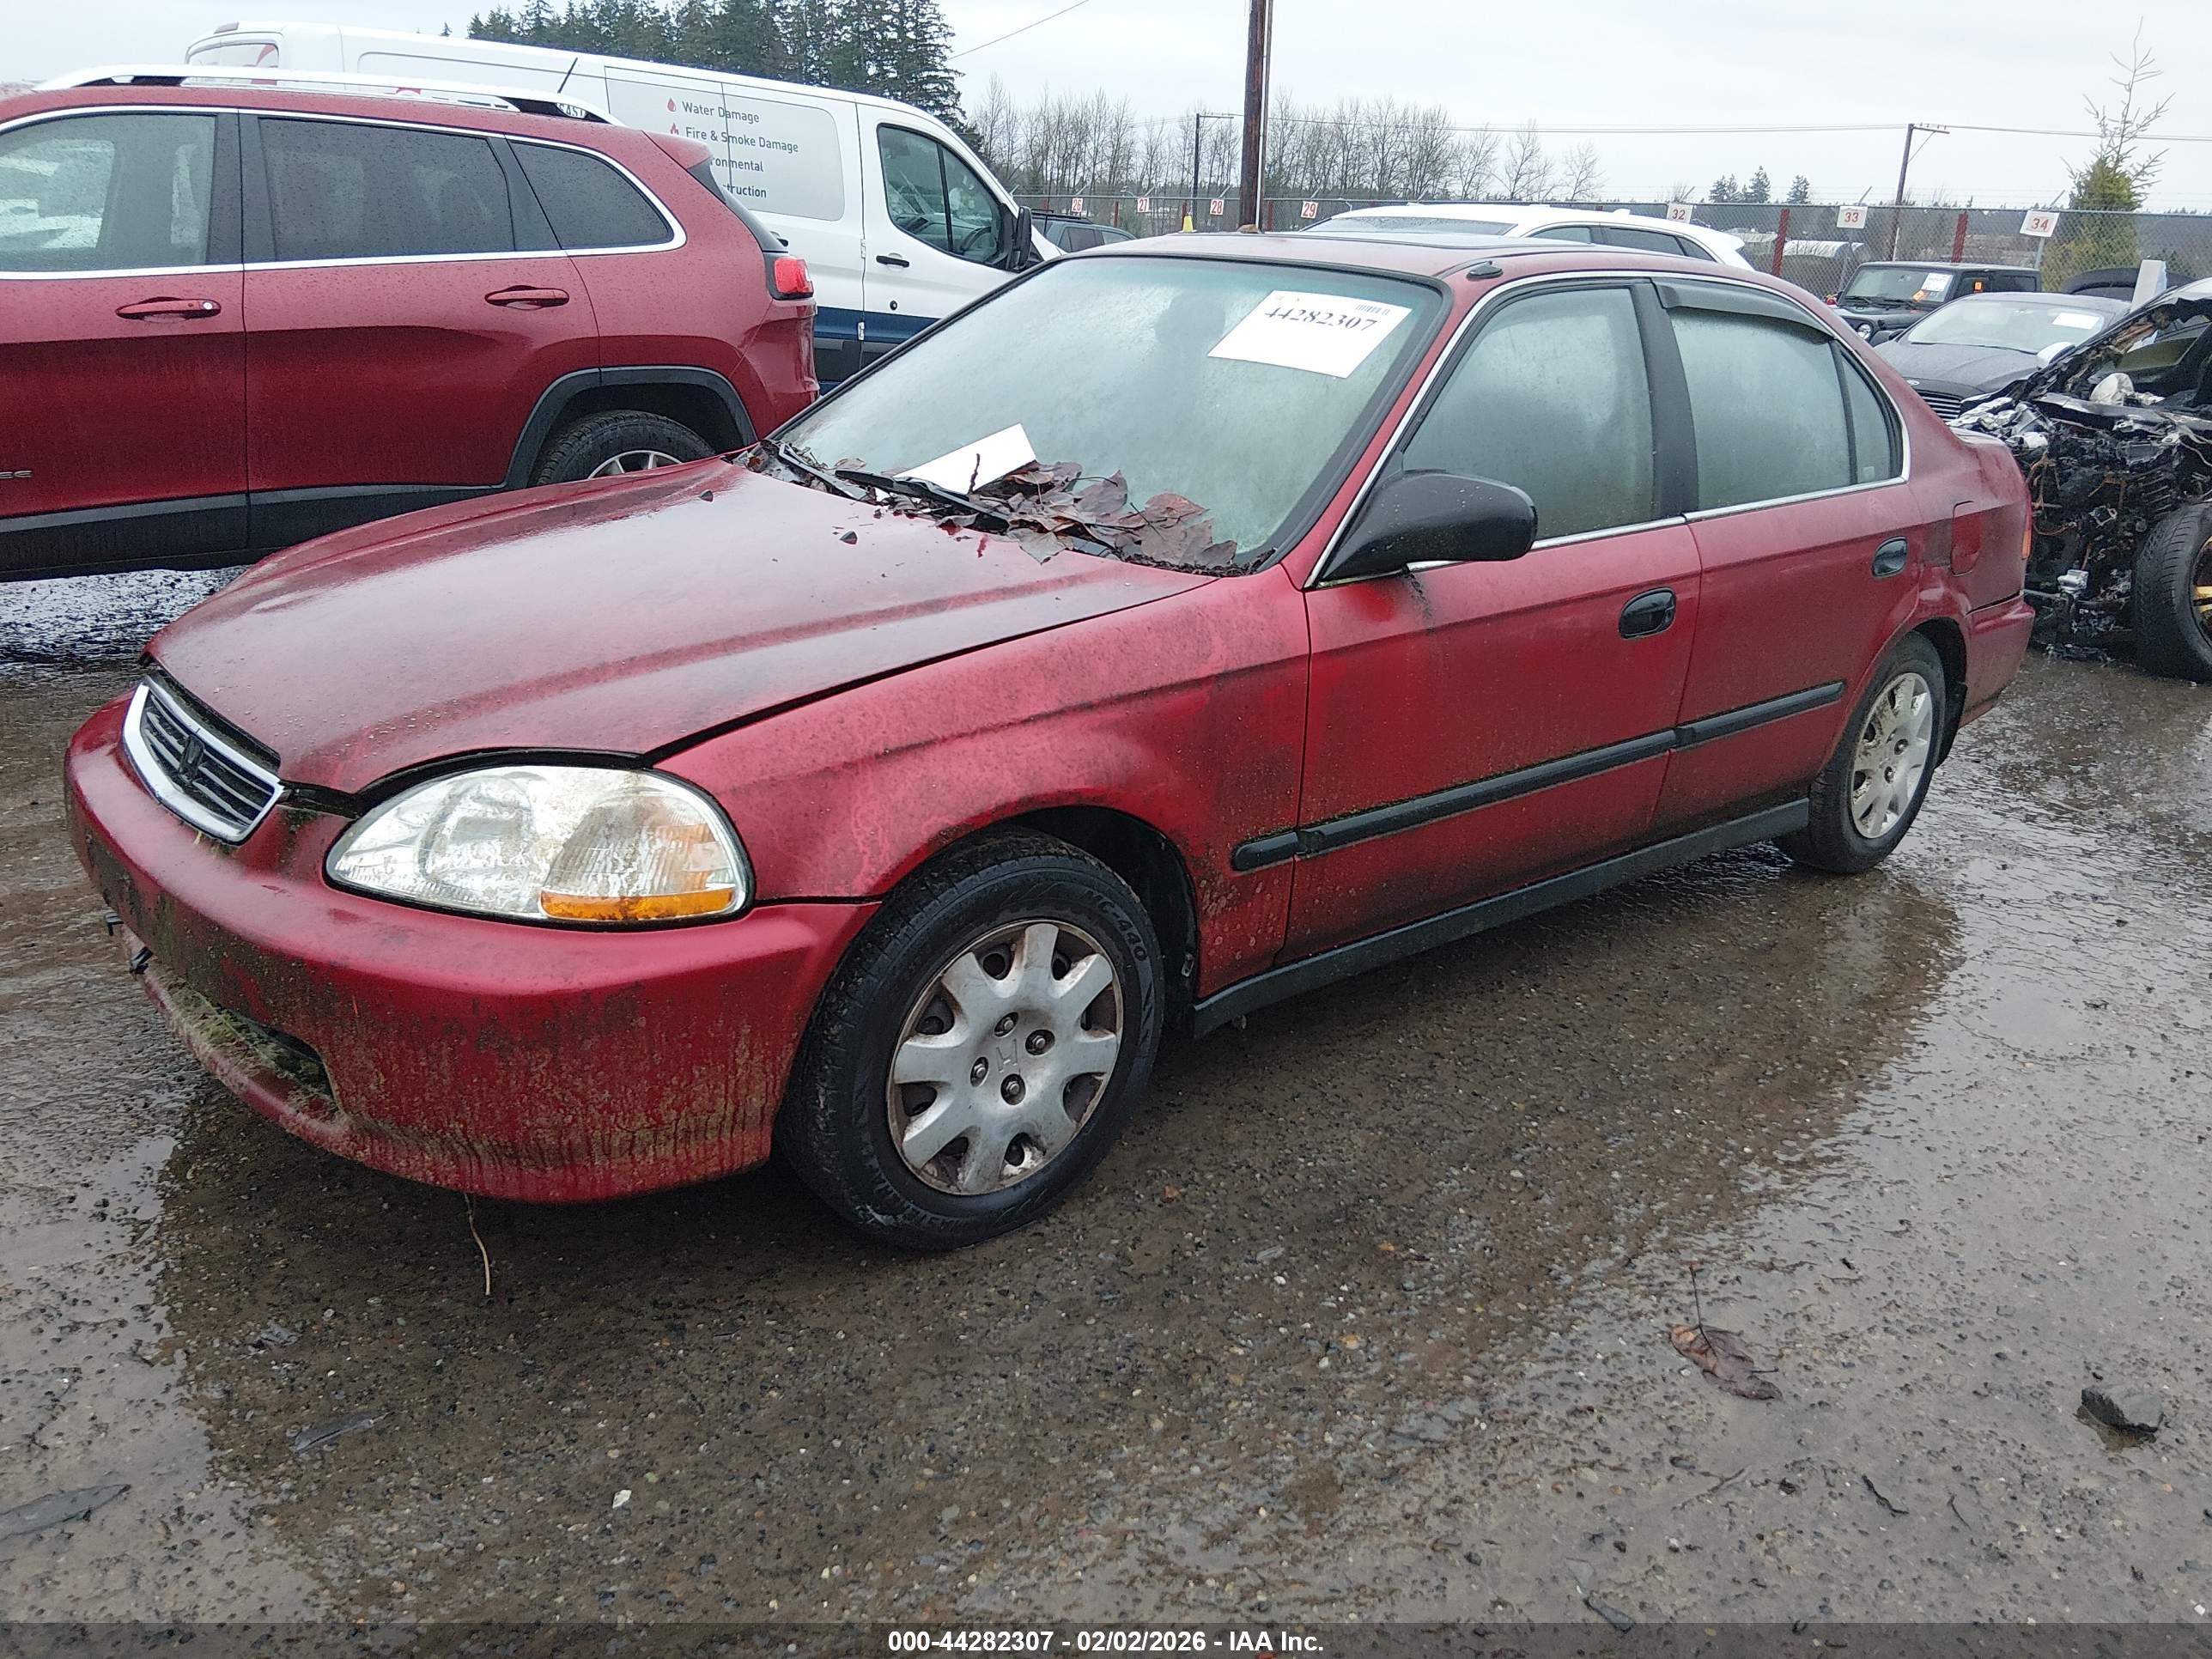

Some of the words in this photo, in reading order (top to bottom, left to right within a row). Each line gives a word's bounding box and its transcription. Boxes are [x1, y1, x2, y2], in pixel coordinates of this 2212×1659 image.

[682, 100, 714, 116] Water
[718, 106, 760, 124] Damage
[685, 126, 707, 140] Fire
[710, 130, 719, 142] &
[720, 131, 756, 147] Smoke
[758, 137, 799, 154] Damage
[723, 183, 767, 198] truction
[1073, 198, 1082, 211] 26
[1139, 198, 1148, 212] 27
[1211, 200, 1223, 214] 28
[1303, 203, 1316, 217] 29
[1672, 209, 1686, 221] 32
[1844, 211, 1859, 223] 33
[2032, 217, 2049, 231] 34
[1264, 307, 1378, 331] 44282307
